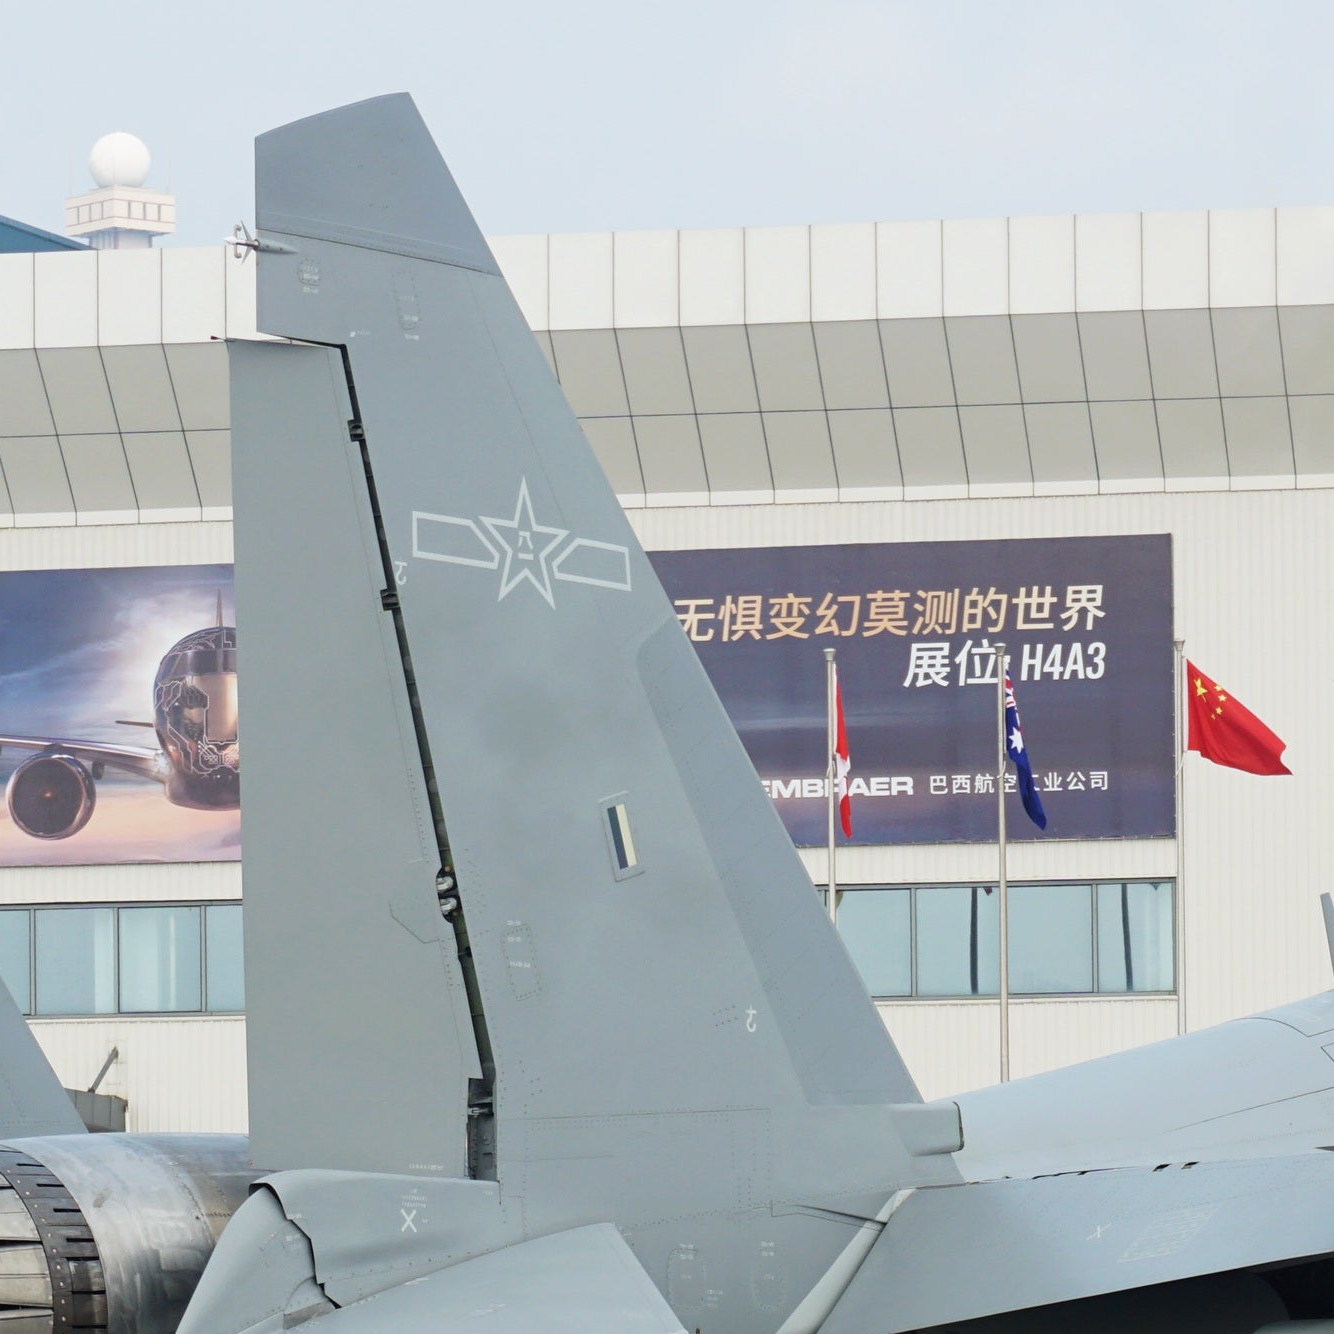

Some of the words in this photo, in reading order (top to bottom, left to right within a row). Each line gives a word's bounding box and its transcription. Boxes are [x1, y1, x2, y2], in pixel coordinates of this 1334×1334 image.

[673, 585, 1107, 643] 无惧变幻莫测的世界
[1020, 641, 1107, 682] H4A3
